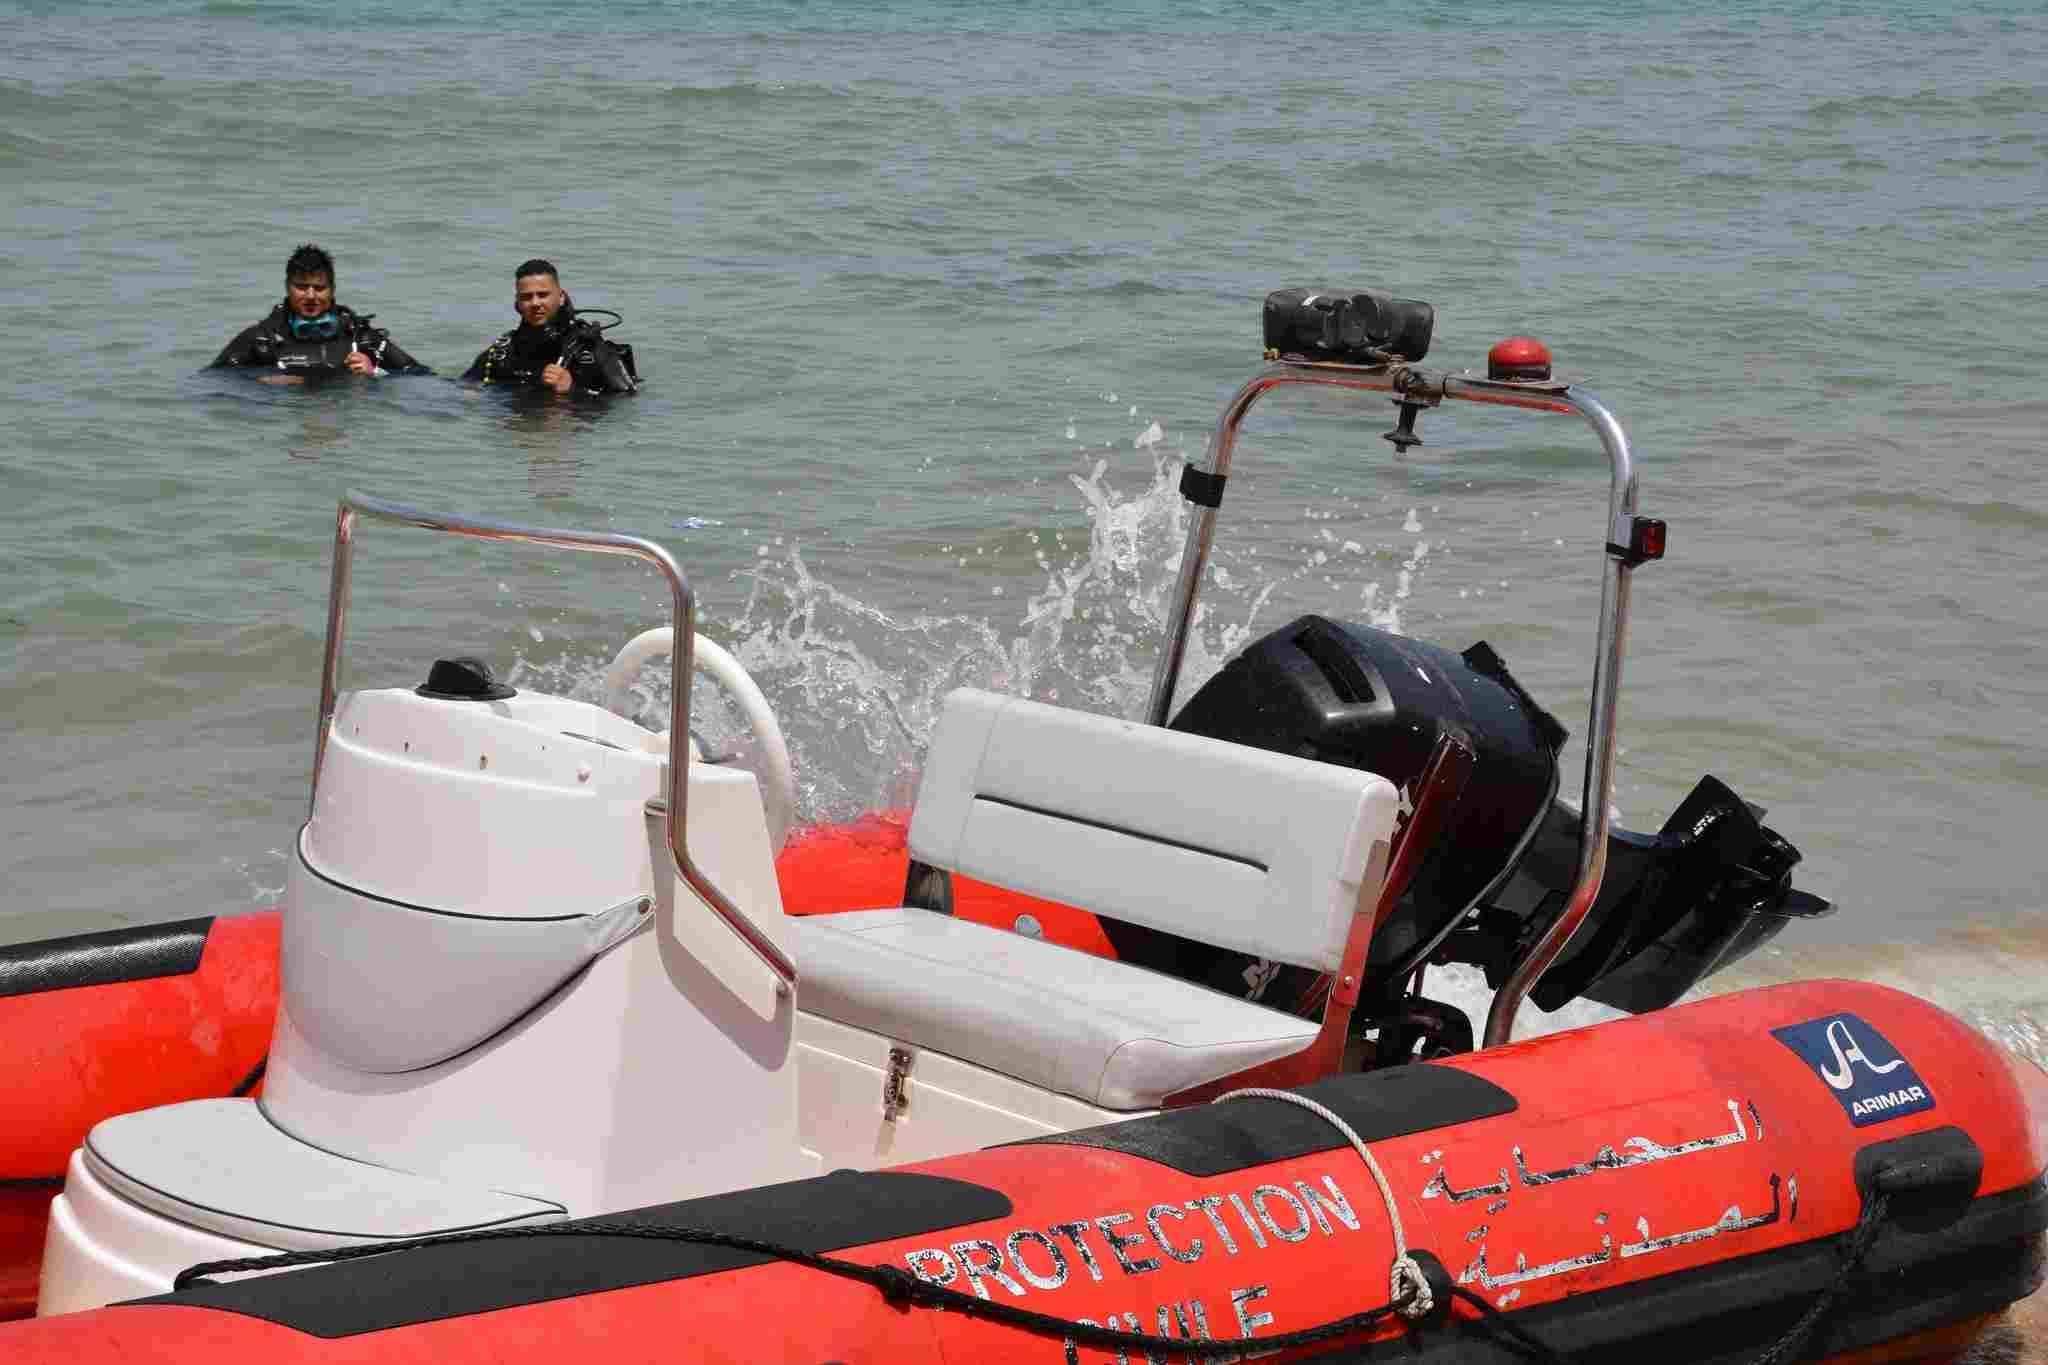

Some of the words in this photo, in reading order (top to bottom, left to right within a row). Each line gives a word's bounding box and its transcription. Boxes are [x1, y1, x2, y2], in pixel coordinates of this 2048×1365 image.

[1420, 1097, 1765, 1216] الحماية
[1852, 1085, 1926, 1117] ARIMAR
[904, 1174, 1363, 1312] PROTECTION
[1457, 1172, 1799, 1308] المدنية
